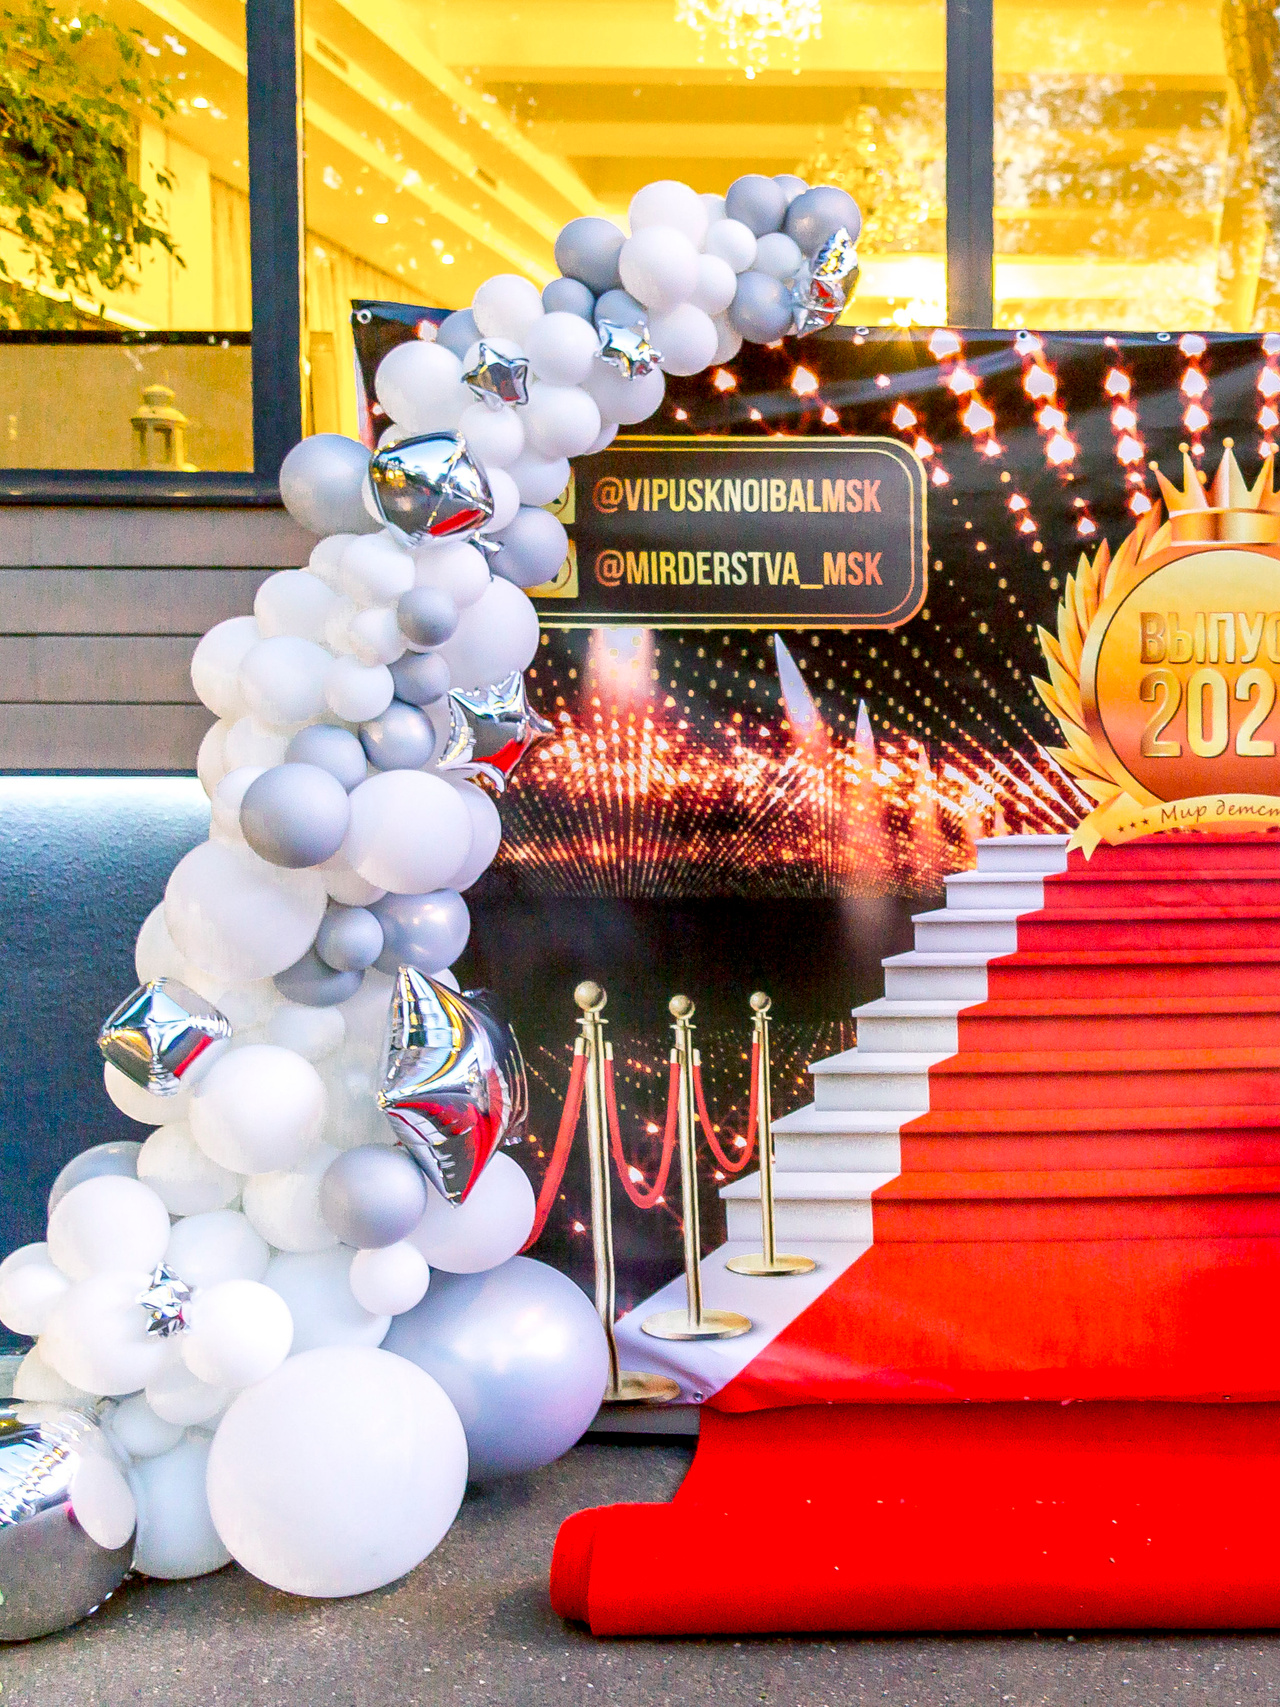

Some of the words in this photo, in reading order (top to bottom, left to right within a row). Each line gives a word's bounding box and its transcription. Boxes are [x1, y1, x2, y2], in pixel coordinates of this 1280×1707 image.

[592, 476, 882, 513] @VIPUSKNOIBALMSK
[594, 549, 884, 589] @MIRDERSTVA_MSK
[1161, 804, 1207, 823] Мир
